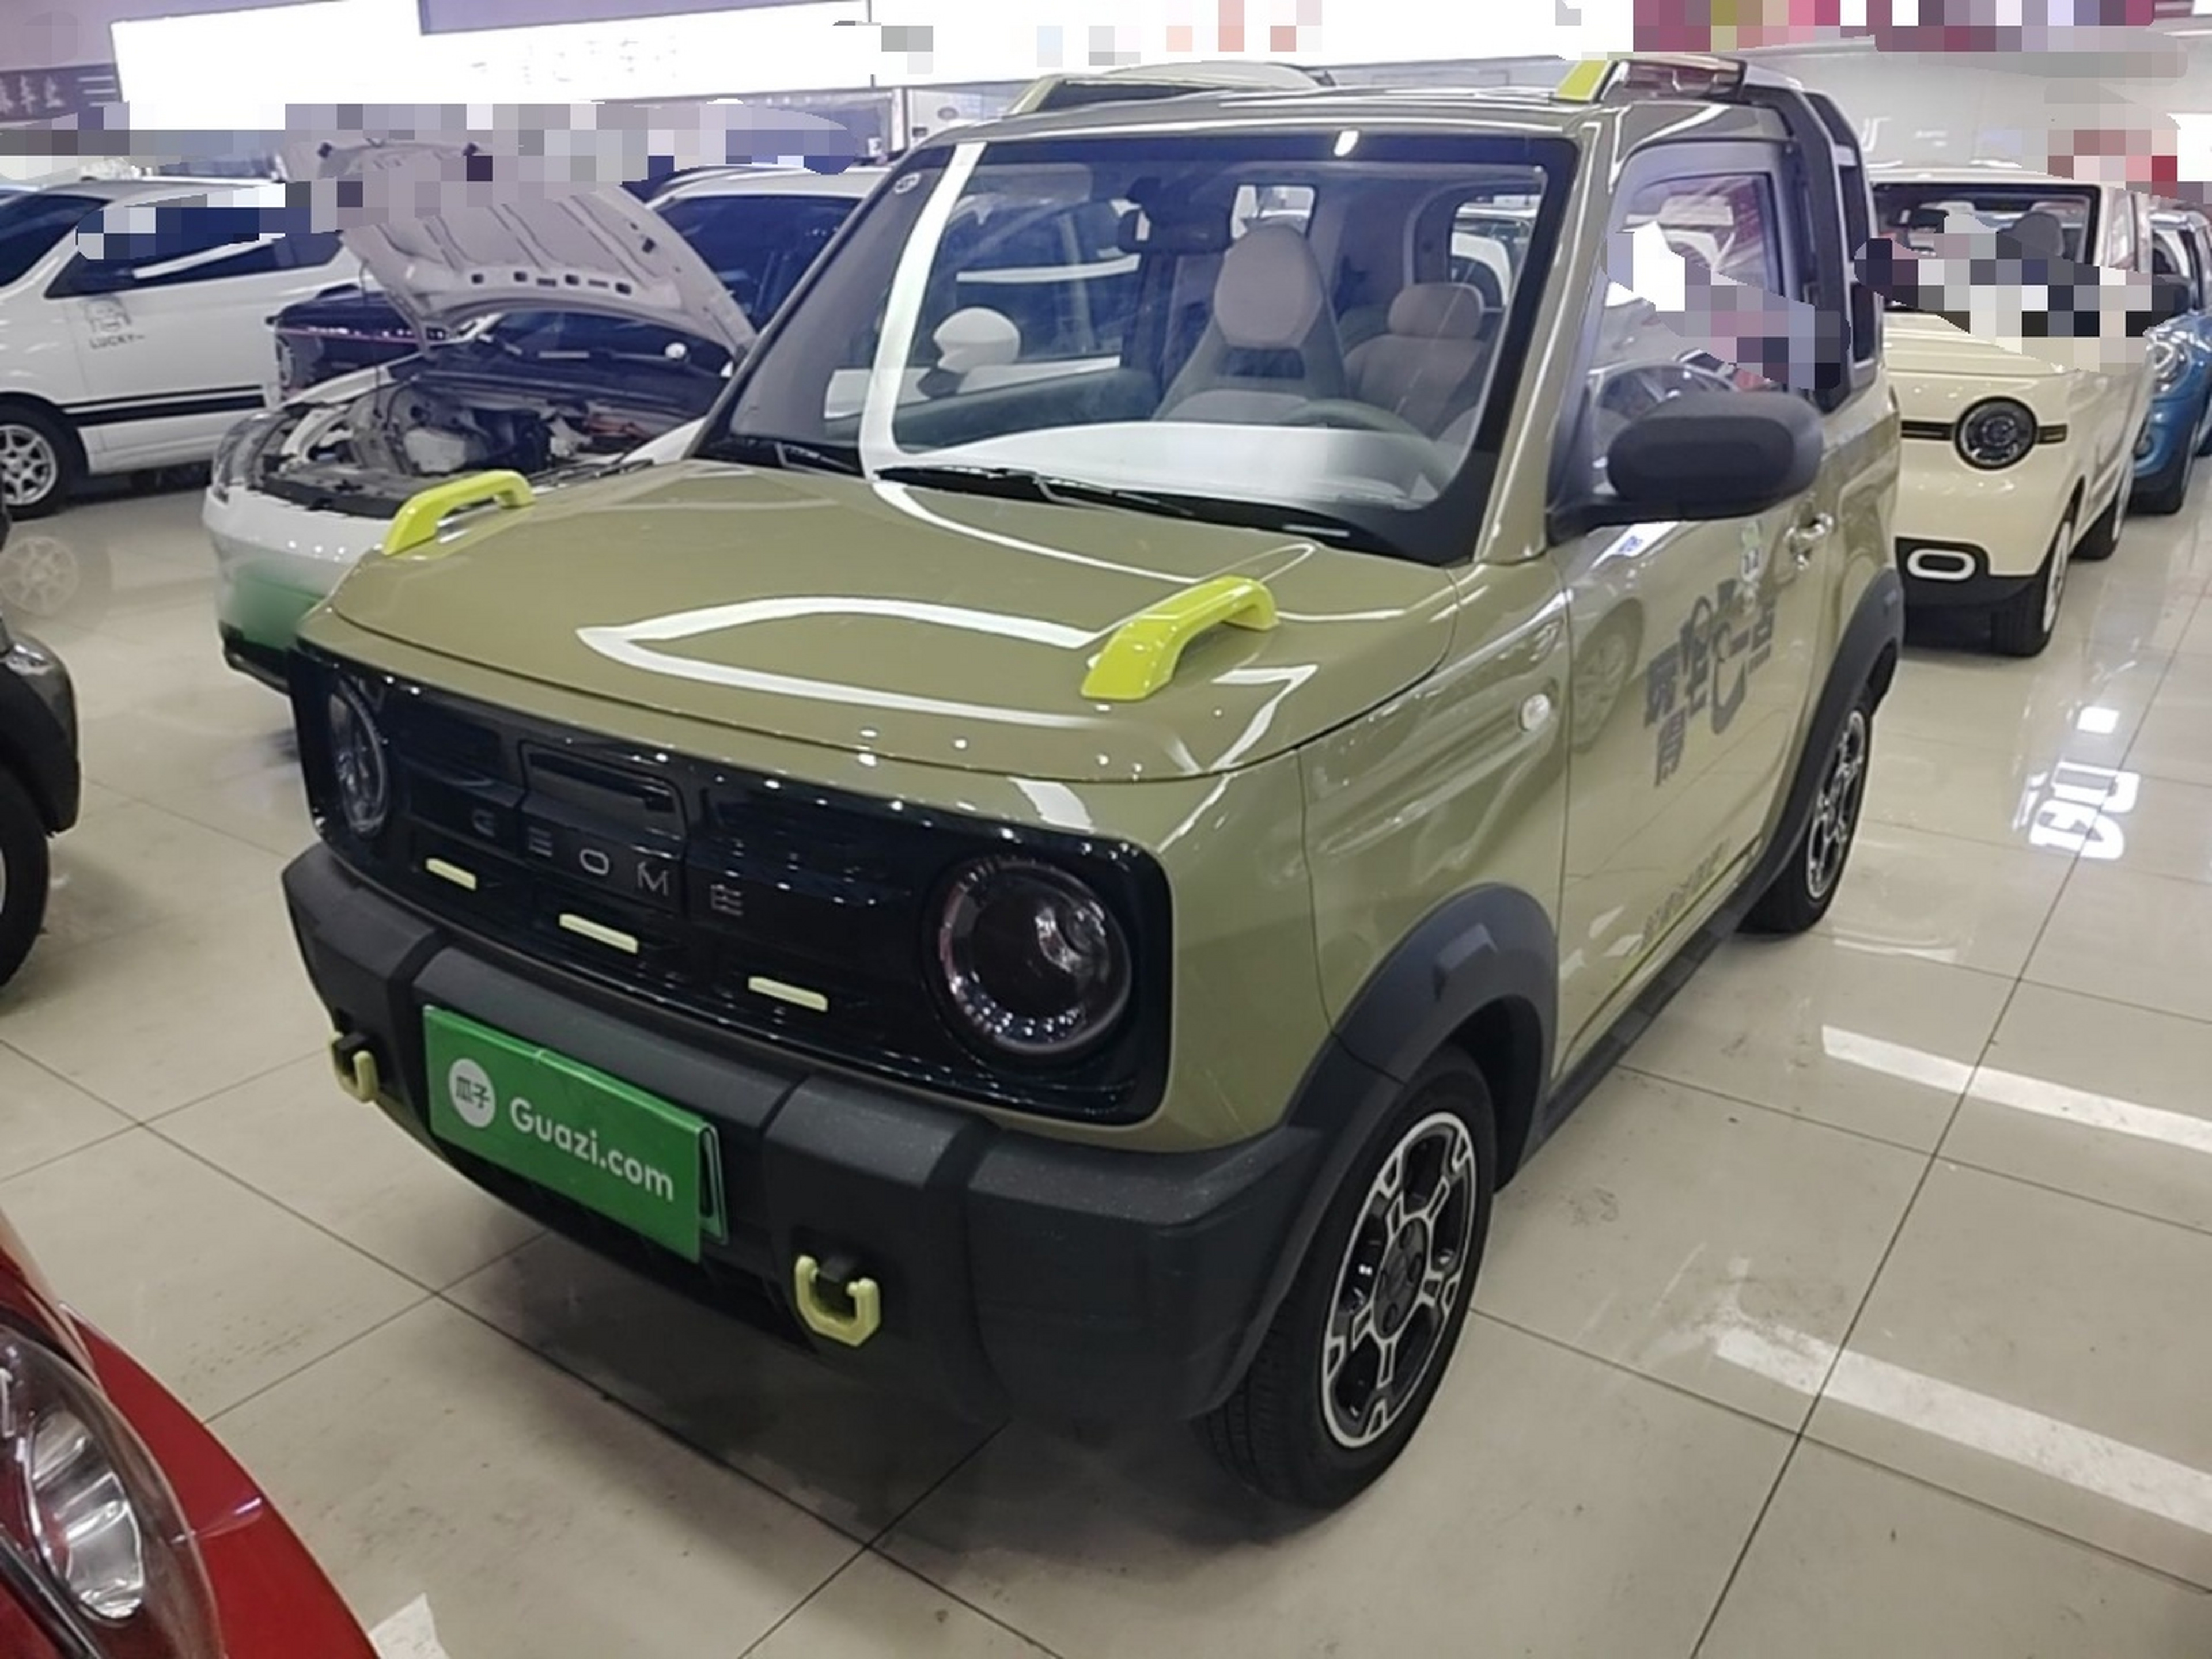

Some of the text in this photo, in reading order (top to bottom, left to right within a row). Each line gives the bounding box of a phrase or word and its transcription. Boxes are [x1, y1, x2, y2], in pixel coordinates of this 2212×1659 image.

[471, 809, 744, 916] GEOME
[455, 1075, 491, 1109] 瓜子
[509, 1096, 674, 1202] Guazi.com
